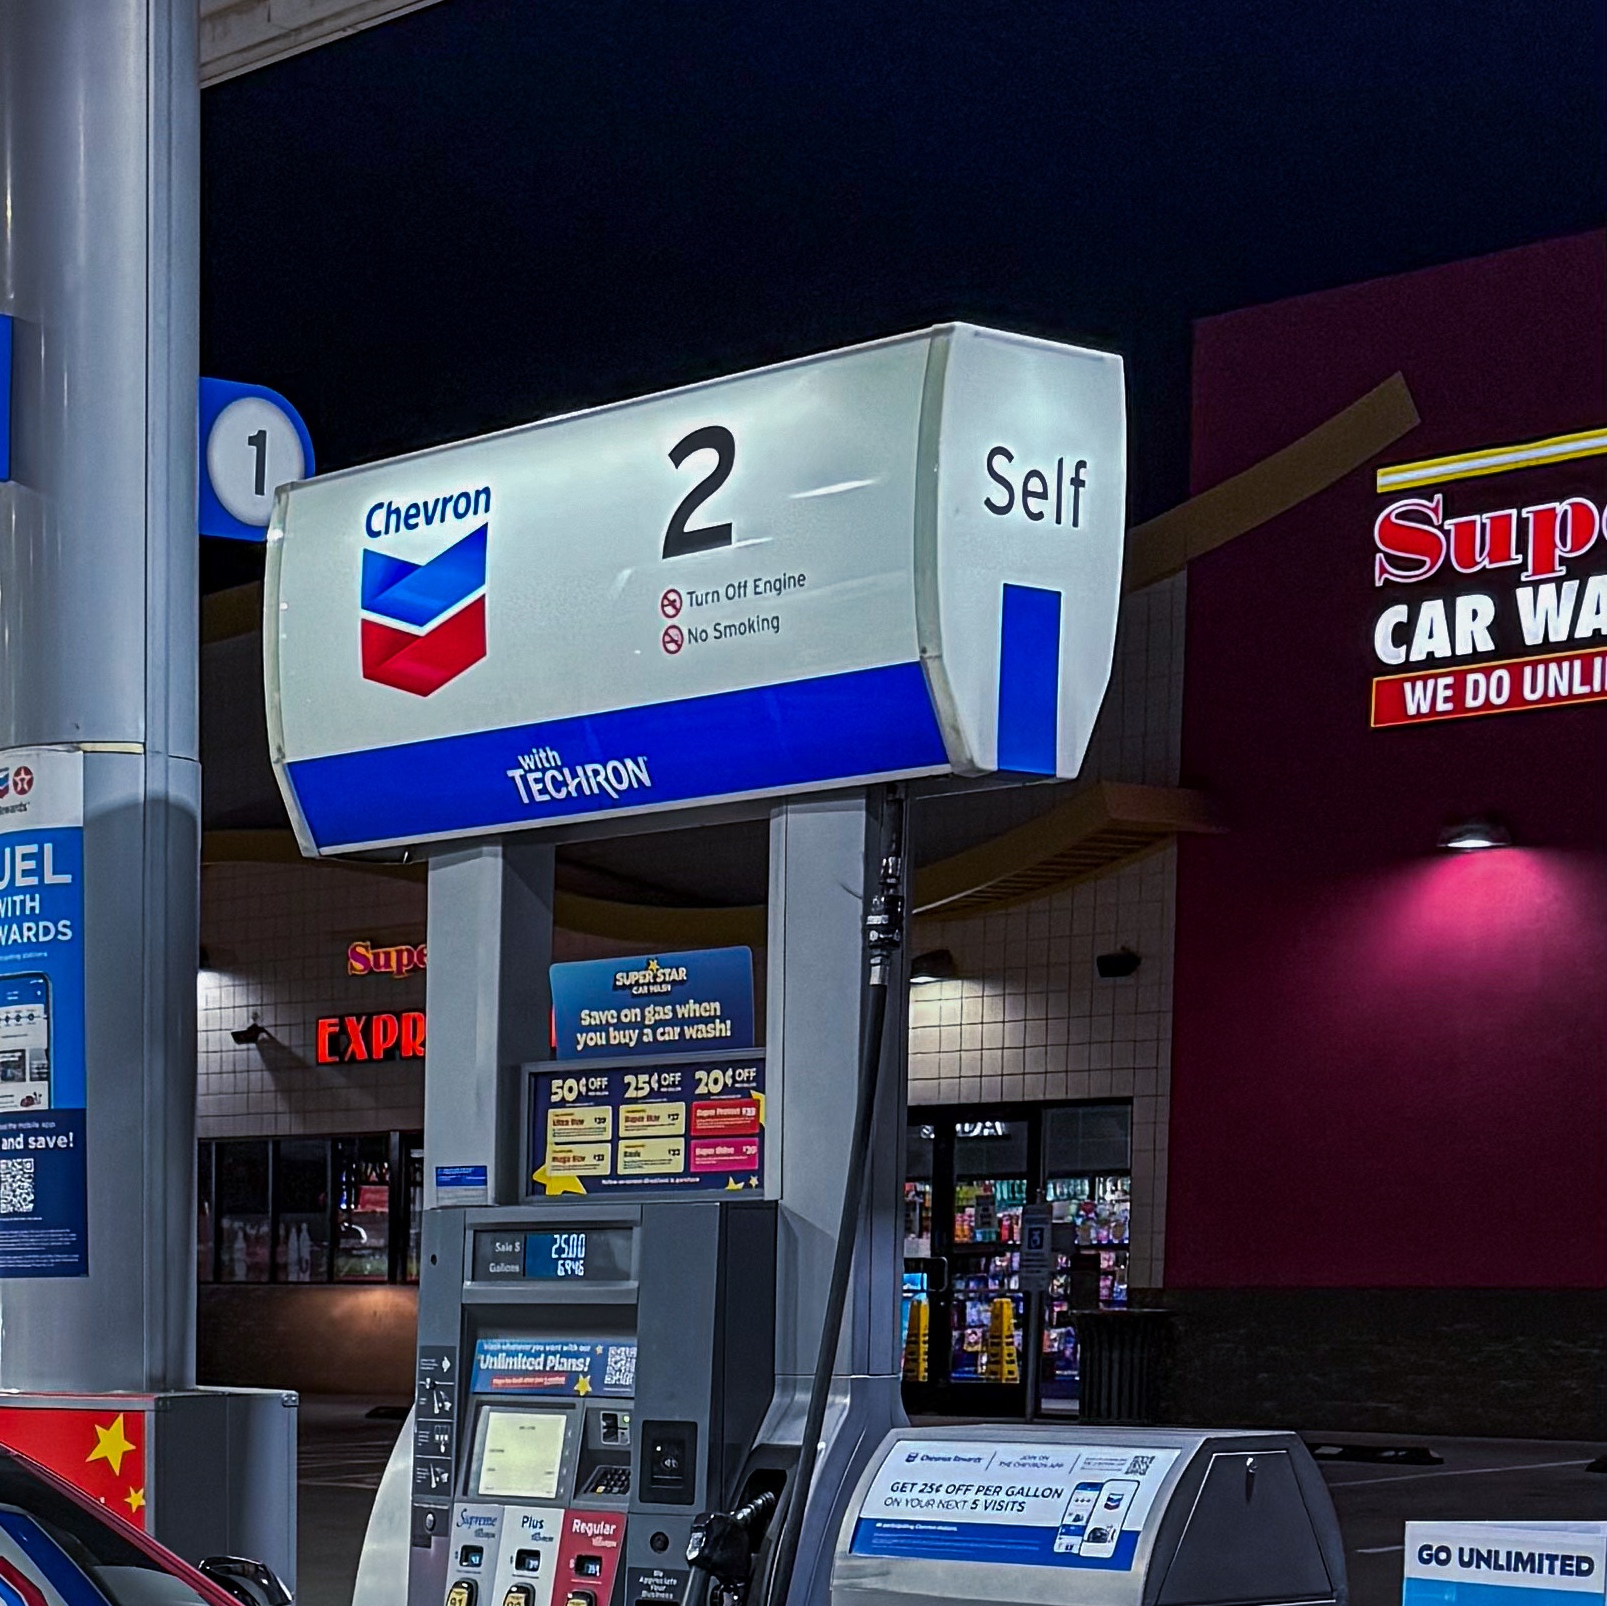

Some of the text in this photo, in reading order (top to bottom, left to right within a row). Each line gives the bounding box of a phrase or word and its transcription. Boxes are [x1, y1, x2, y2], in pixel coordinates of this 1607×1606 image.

[247, 430, 267, 496] 1
[662, 426, 736, 559] 2
[984, 446, 1087, 528] Self
[365, 486, 491, 539] Chevron
[1374, 493, 1607, 587] Sup
[686, 571, 807, 609] Turn Off Engine
[687, 613, 780, 645] No Smoking
[1374, 594, 1496, 665] CAR
[1403, 656, 1607, 716] WE DO UNLI
[517, 746, 562, 771] with
[506, 756, 652, 804] TECHRON
[616, 967, 687, 986] SUPER STAR
[632, 984, 671, 994] CAR WASH
[581, 999, 721, 1026] Save on gas when
[318, 1012, 426, 1063] EXPR
[576, 1020, 731, 1051] you buy a car wash!
[551, 1077, 608, 1102] 50¢ OFF
[624, 1072, 681, 1098] 25¢ OFF
[695, 1068, 756, 1094] 20¢ OFF
[2, 1133, 24, 1150] and
[28, 1132, 73, 1148] save!
[495, 1242, 512, 1253] Sale
[489, 1263, 520, 1273] Gallons
[479, 1353, 590, 1372] Unlimited Plans!
[891, 1482, 1064, 1499] GET 25¢ OFF PER GALLON
[884, 1497, 1026, 1512] ON YOUR NEXT 5 VISITS
[456, 1508, 497, 1529] Supreme
[522, 1515, 544, 1529] Plus
[572, 1519, 616, 1537] Regular
[1418, 1544, 1595, 1577] GO UNLIMITED
